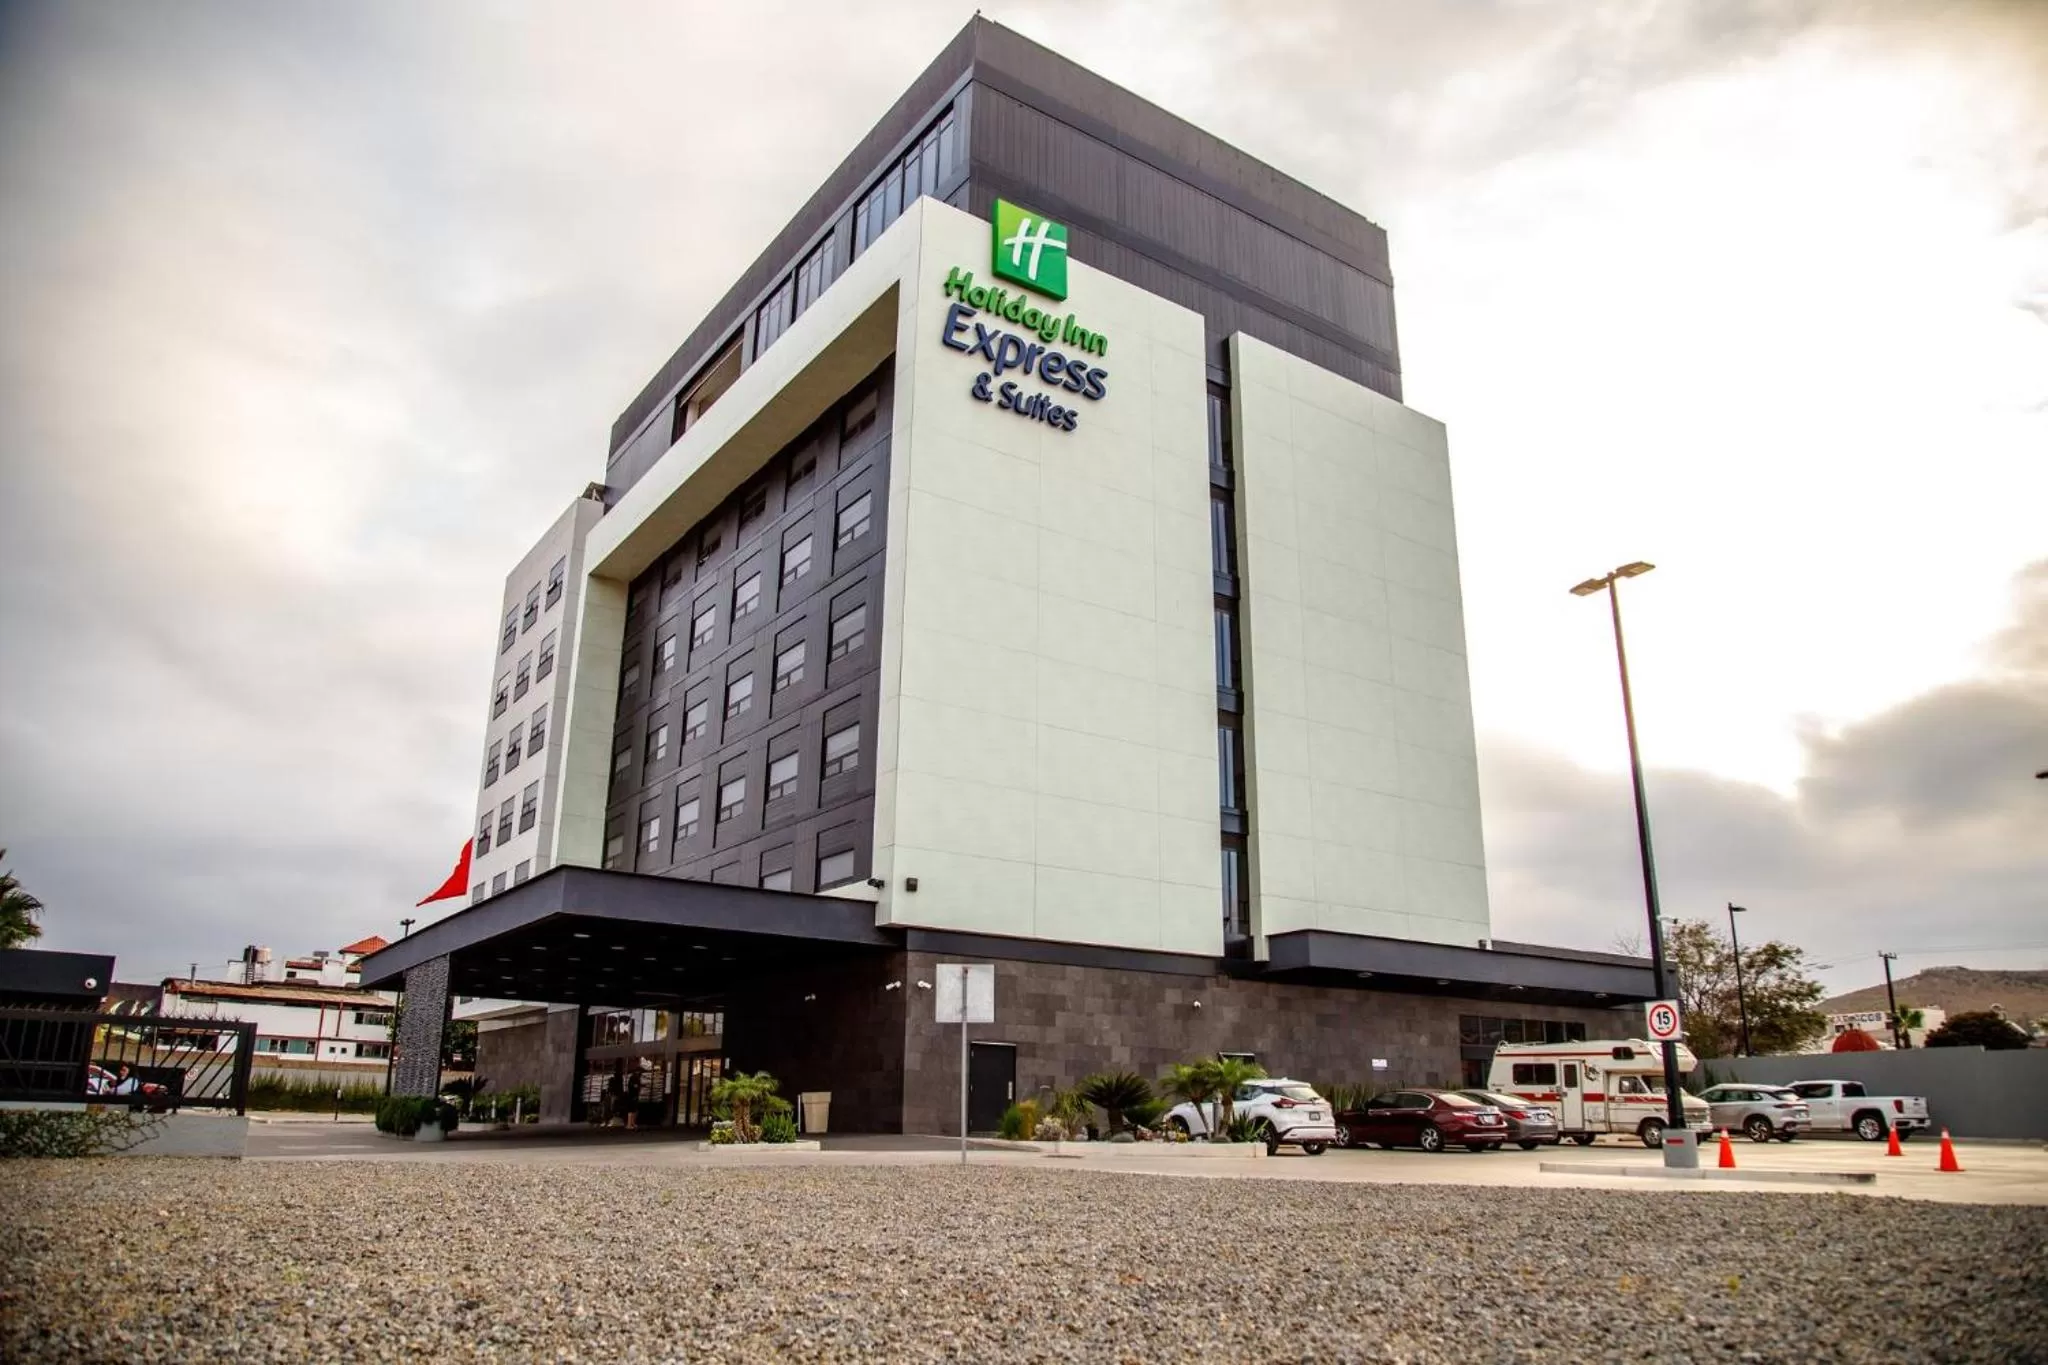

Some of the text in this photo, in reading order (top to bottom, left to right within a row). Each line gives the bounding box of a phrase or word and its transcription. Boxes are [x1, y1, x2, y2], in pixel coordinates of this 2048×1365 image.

[944, 266, 1108, 357] Holiday Inn
[942, 303, 1108, 401] Express
[972, 372, 1079, 432] & Suites
[1656, 1011, 1670, 1025] 15
